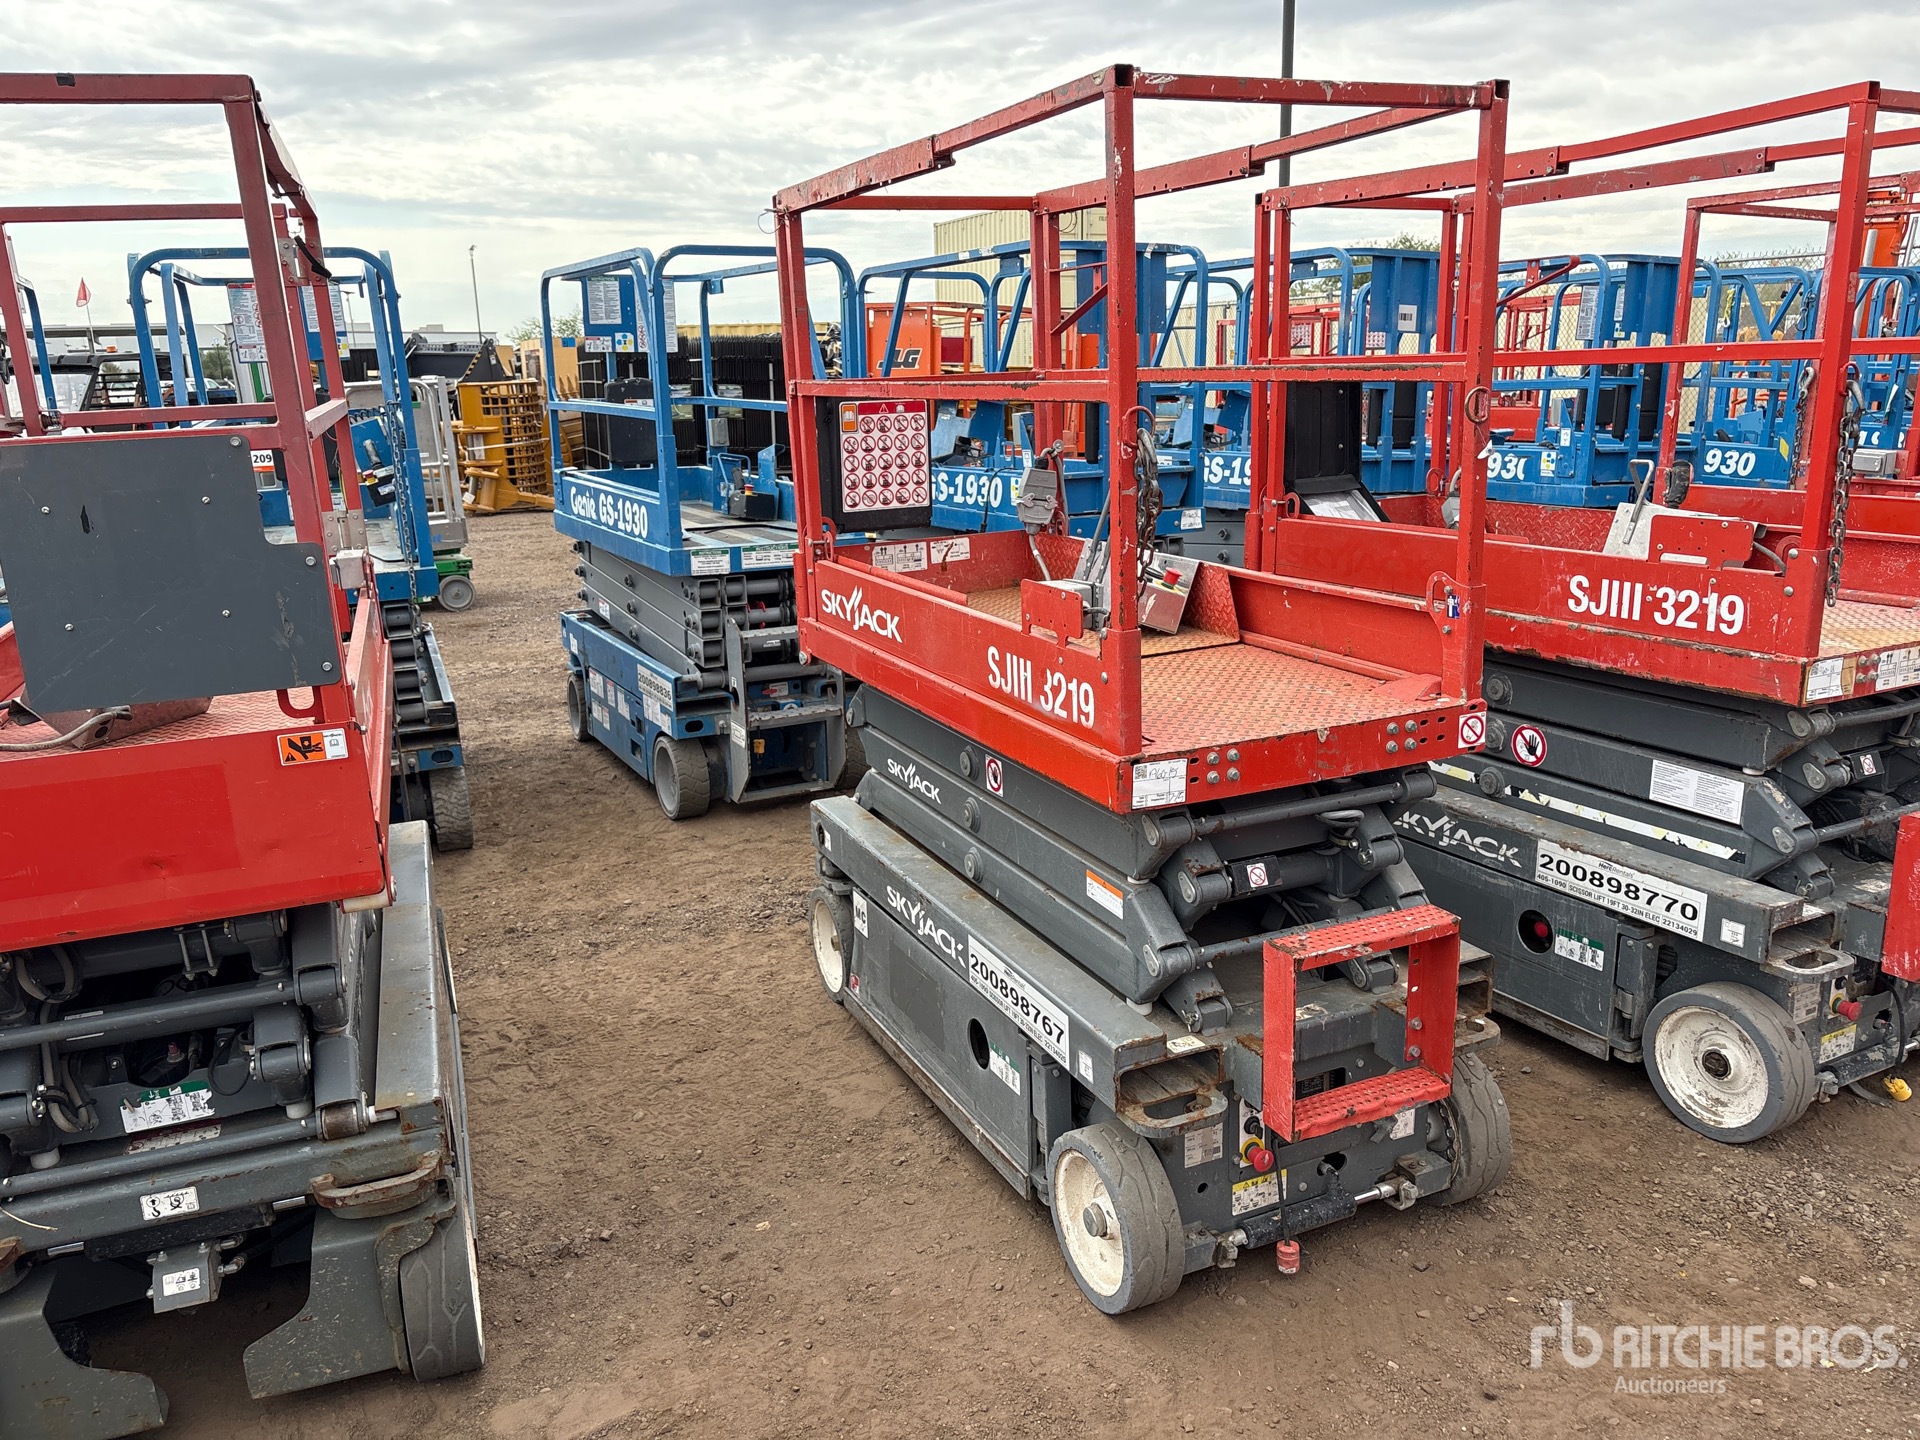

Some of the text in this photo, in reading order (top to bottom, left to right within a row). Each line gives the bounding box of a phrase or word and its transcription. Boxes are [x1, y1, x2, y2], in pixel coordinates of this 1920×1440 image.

[1703, 448, 1756, 477] 930
[570, 486, 648, 539] Genie GS-1930
[821, 585, 903, 643] SKYJACK
[1567, 575, 1745, 635] SJIII 3219
[1040, 668, 1095, 729] 3219
[887, 758, 942, 804] SKYJACK
[1537, 873, 1698, 936] 405-1090 SCISSOR LIFT 19FT 30-32IN ELEC 22134029
[1539, 853, 1698, 921] 200898770
[970, 953, 1065, 1044] 200898767
